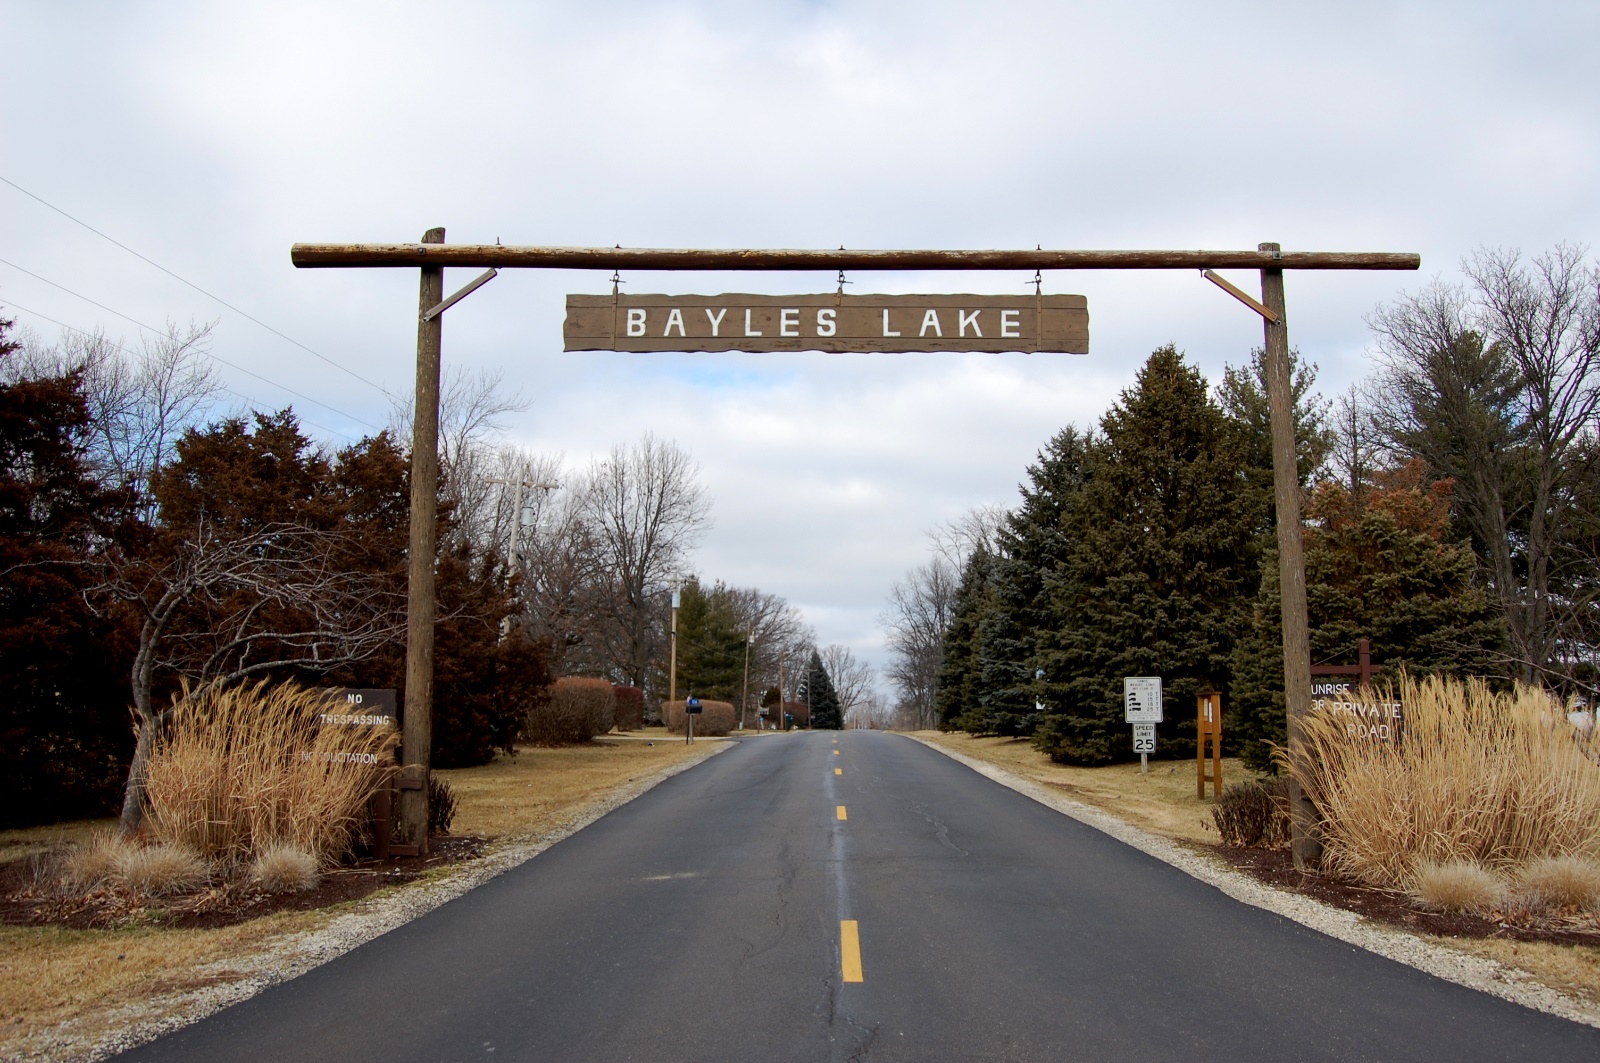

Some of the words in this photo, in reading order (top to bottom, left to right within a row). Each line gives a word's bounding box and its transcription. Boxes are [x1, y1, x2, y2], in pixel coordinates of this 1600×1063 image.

[626, 308, 837, 338] BAYLES
[882, 308, 1021, 338] LAKE
[1311, 683, 1350, 695] UNRISE
[347, 693, 363, 704] NO
[1333, 702, 1402, 718] PRIVATE
[320, 713, 389, 726] TRESPASSING
[1346, 723, 1389, 739] ROAD
[1135, 739, 1154, 750] 25
